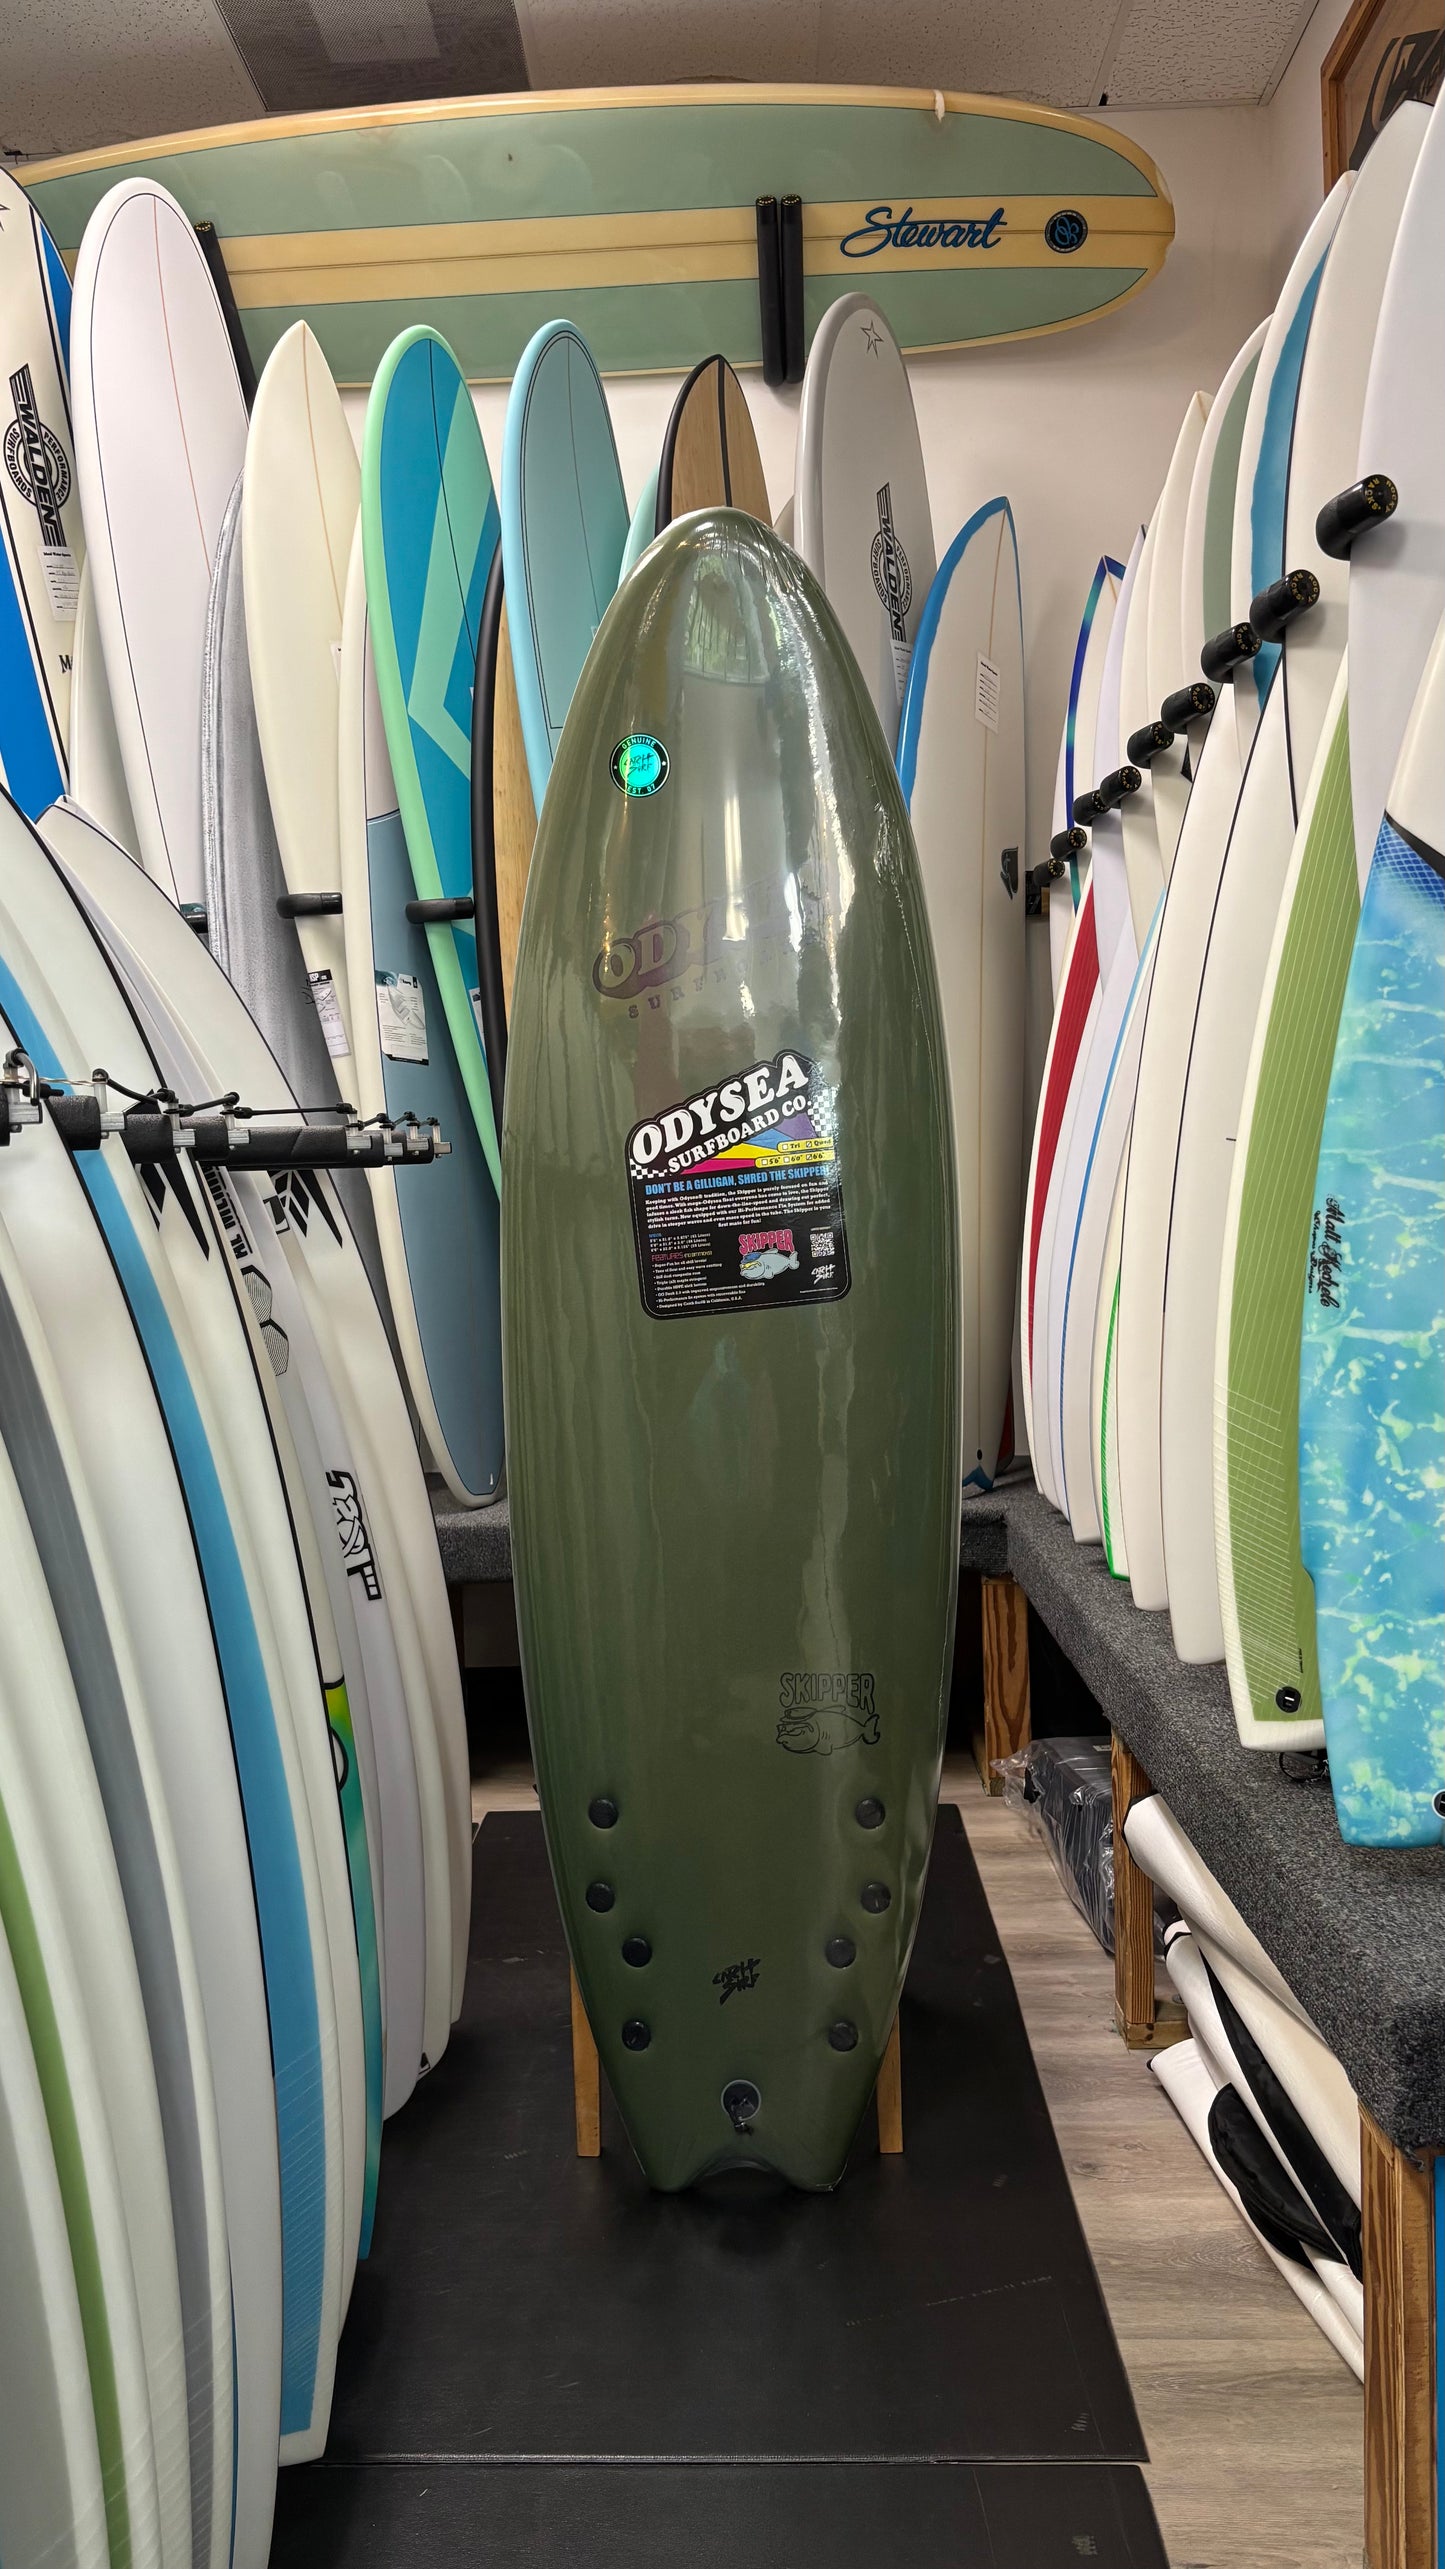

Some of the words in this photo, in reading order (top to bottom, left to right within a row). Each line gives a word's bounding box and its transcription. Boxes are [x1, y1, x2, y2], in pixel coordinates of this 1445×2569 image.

[840, 206, 1007, 257] Stewart
[5, 428, 33, 498] SURFBOARDS
[18, 400, 59, 527] WALDEN
[43, 431, 70, 500] PERFORMANCE
[882, 517, 904, 629] WALDEN
[622, 736, 657, 749] GENUINE
[632, 1053, 809, 1165] ODYSEA
[667, 1107, 780, 1174] SURFBOARD
[782, 1095, 812, 1118] CO.
[645, 1182, 671, 1194] DON'T
[673, 1181, 685, 1191] BE
[686, 1180, 692, 1190] A
[694, 1175, 736, 1189] GILLIGAN,
[738, 1172, 767, 1184] SHRED
[769, 1170, 786, 1181] THE
[738, 1229, 795, 1254] SKIPPER
[1324, 1195, 1345, 1244] Matt
[779, 1672, 875, 1715] SKIPPER
